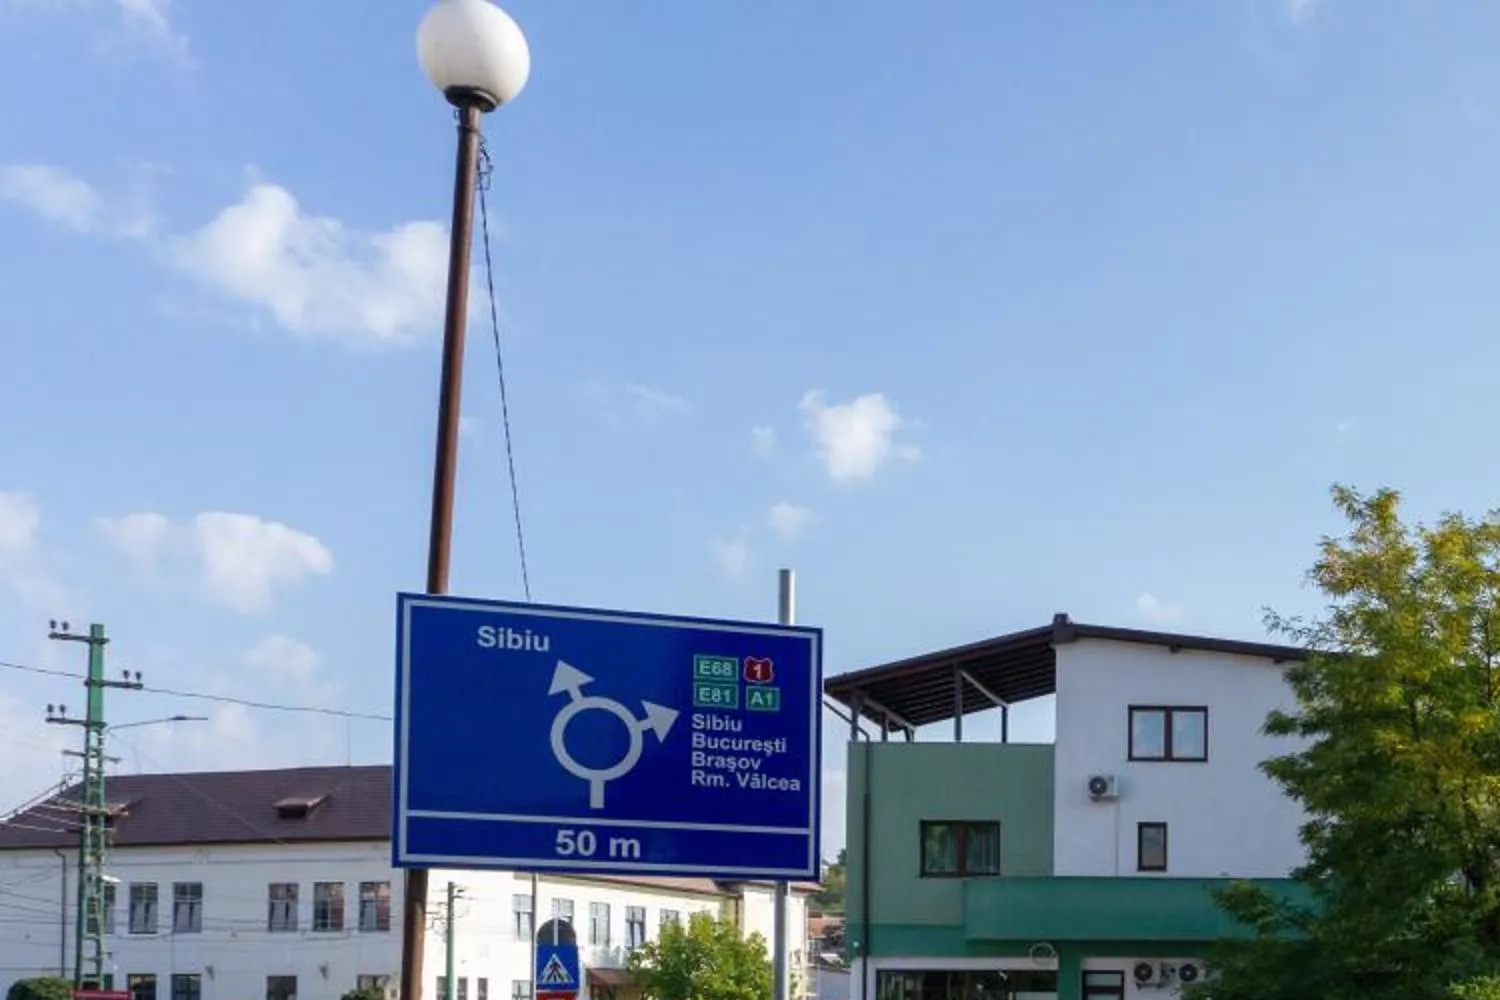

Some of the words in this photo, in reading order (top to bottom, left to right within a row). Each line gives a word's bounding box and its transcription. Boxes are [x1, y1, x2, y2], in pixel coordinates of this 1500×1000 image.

[477, 626, 550, 652] Sibiu
[699, 660, 733, 677] E68
[753, 663, 762, 679] 1
[699, 687, 732, 703] E81
[750, 691, 774, 706] A1
[691, 713, 743, 732] Sibiu
[691, 769, 731, 787] Rm.
[555, 829, 597, 857] 50
[609, 834, 641, 858] m
